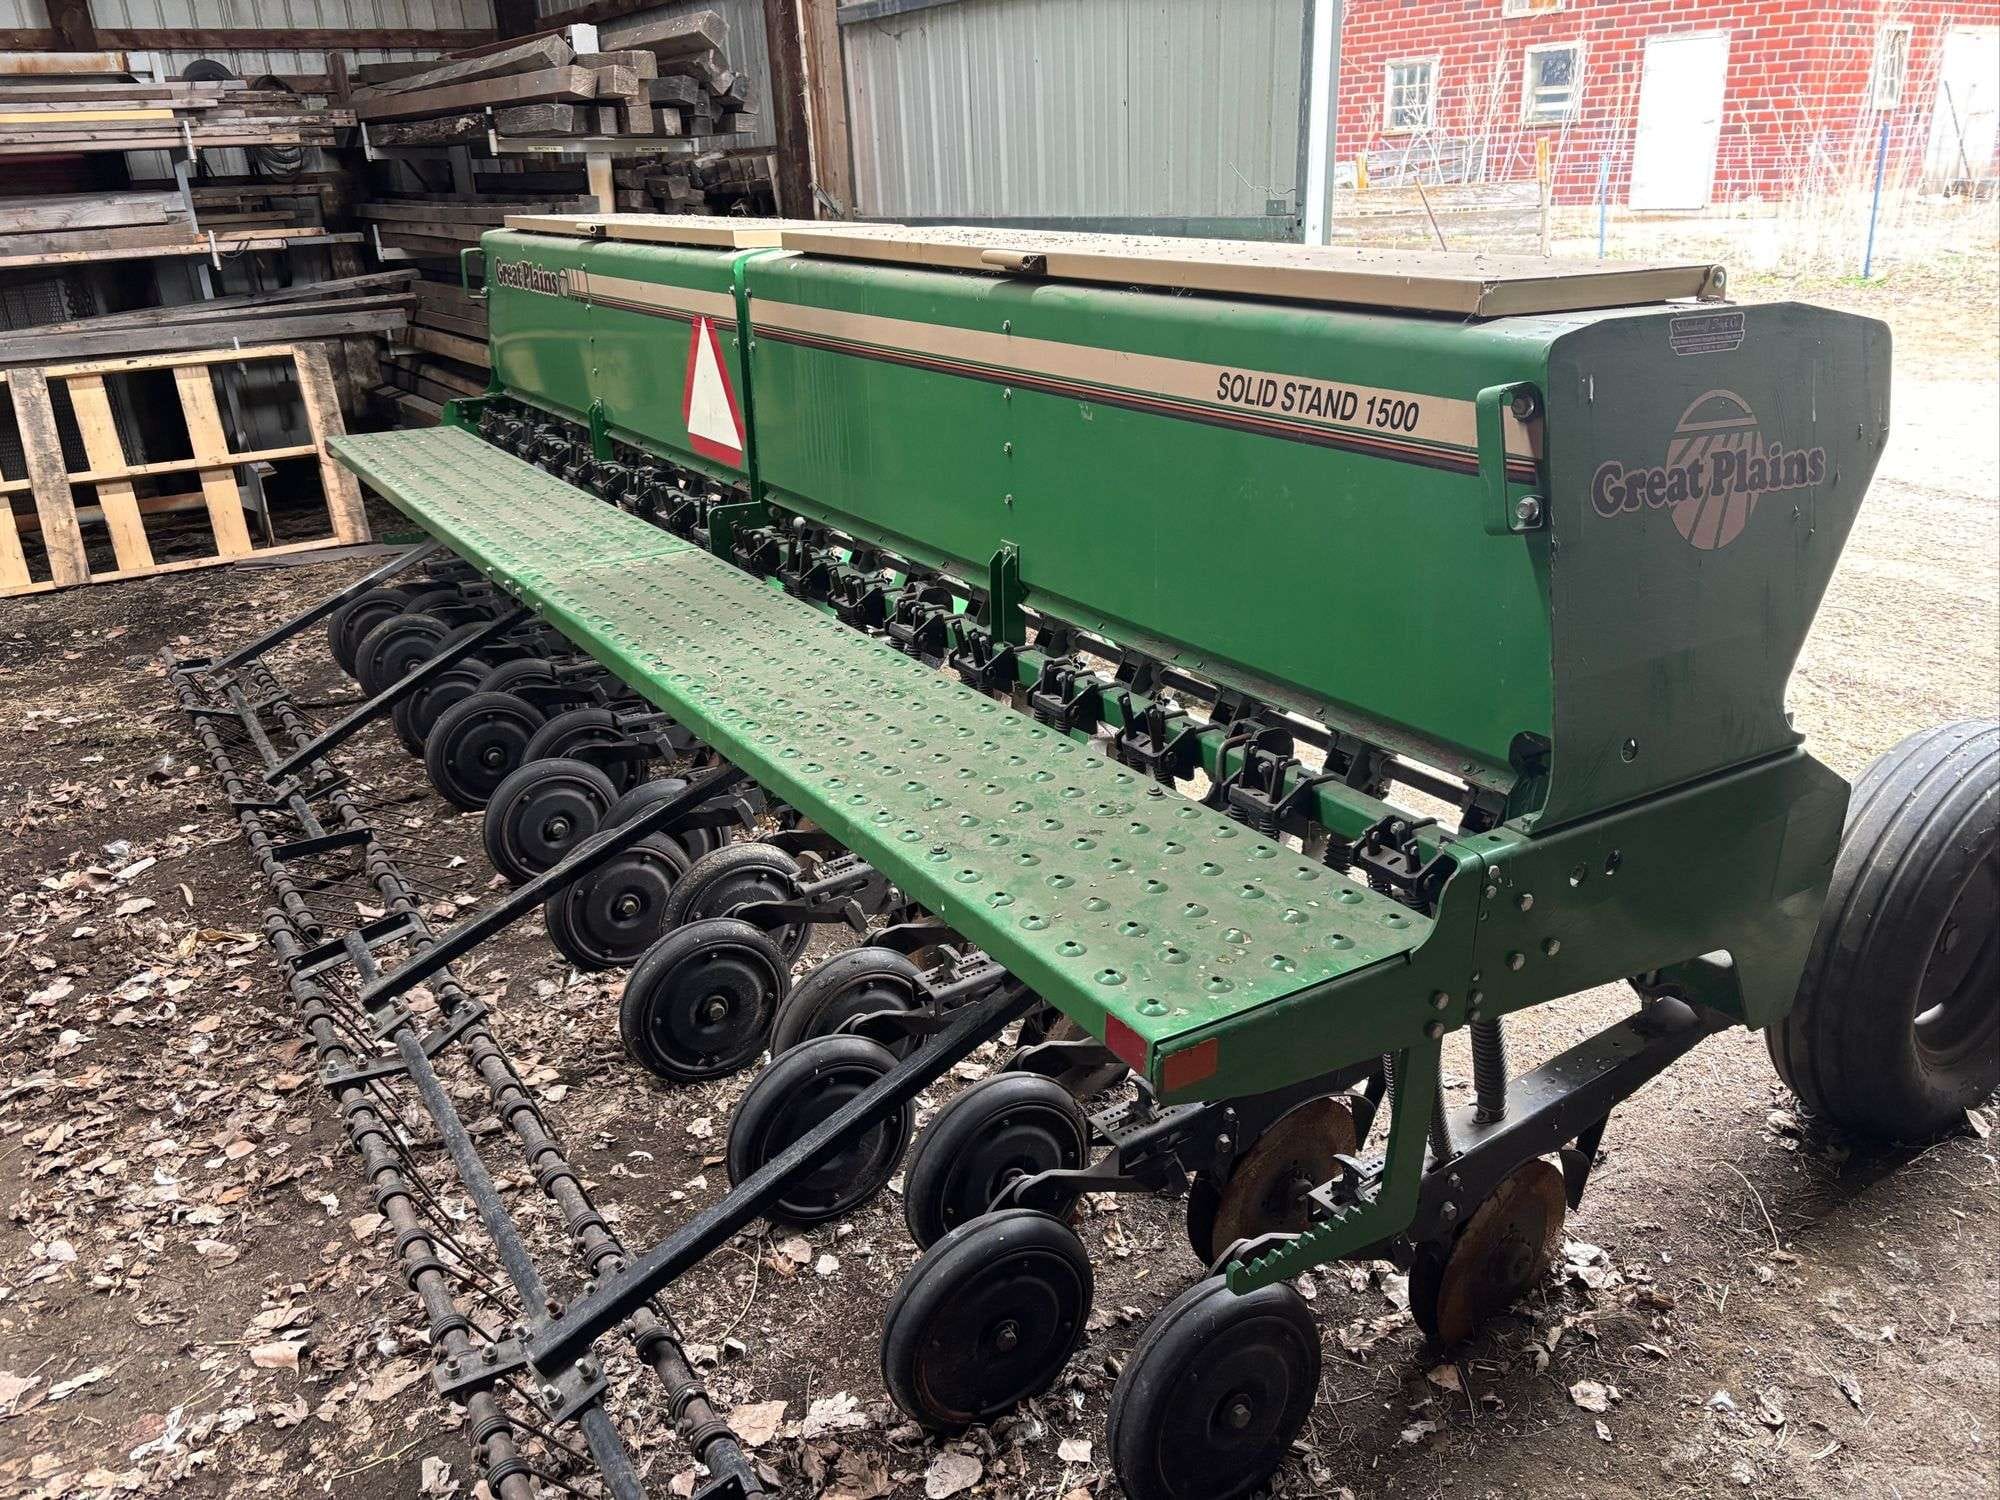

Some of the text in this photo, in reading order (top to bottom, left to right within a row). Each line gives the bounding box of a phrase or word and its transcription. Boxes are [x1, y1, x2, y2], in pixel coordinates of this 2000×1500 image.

[495, 256, 558, 296] Great Plains
[1217, 372, 1420, 432] SOLID STAND 1500
[1593, 443, 1825, 516] Great Plains
